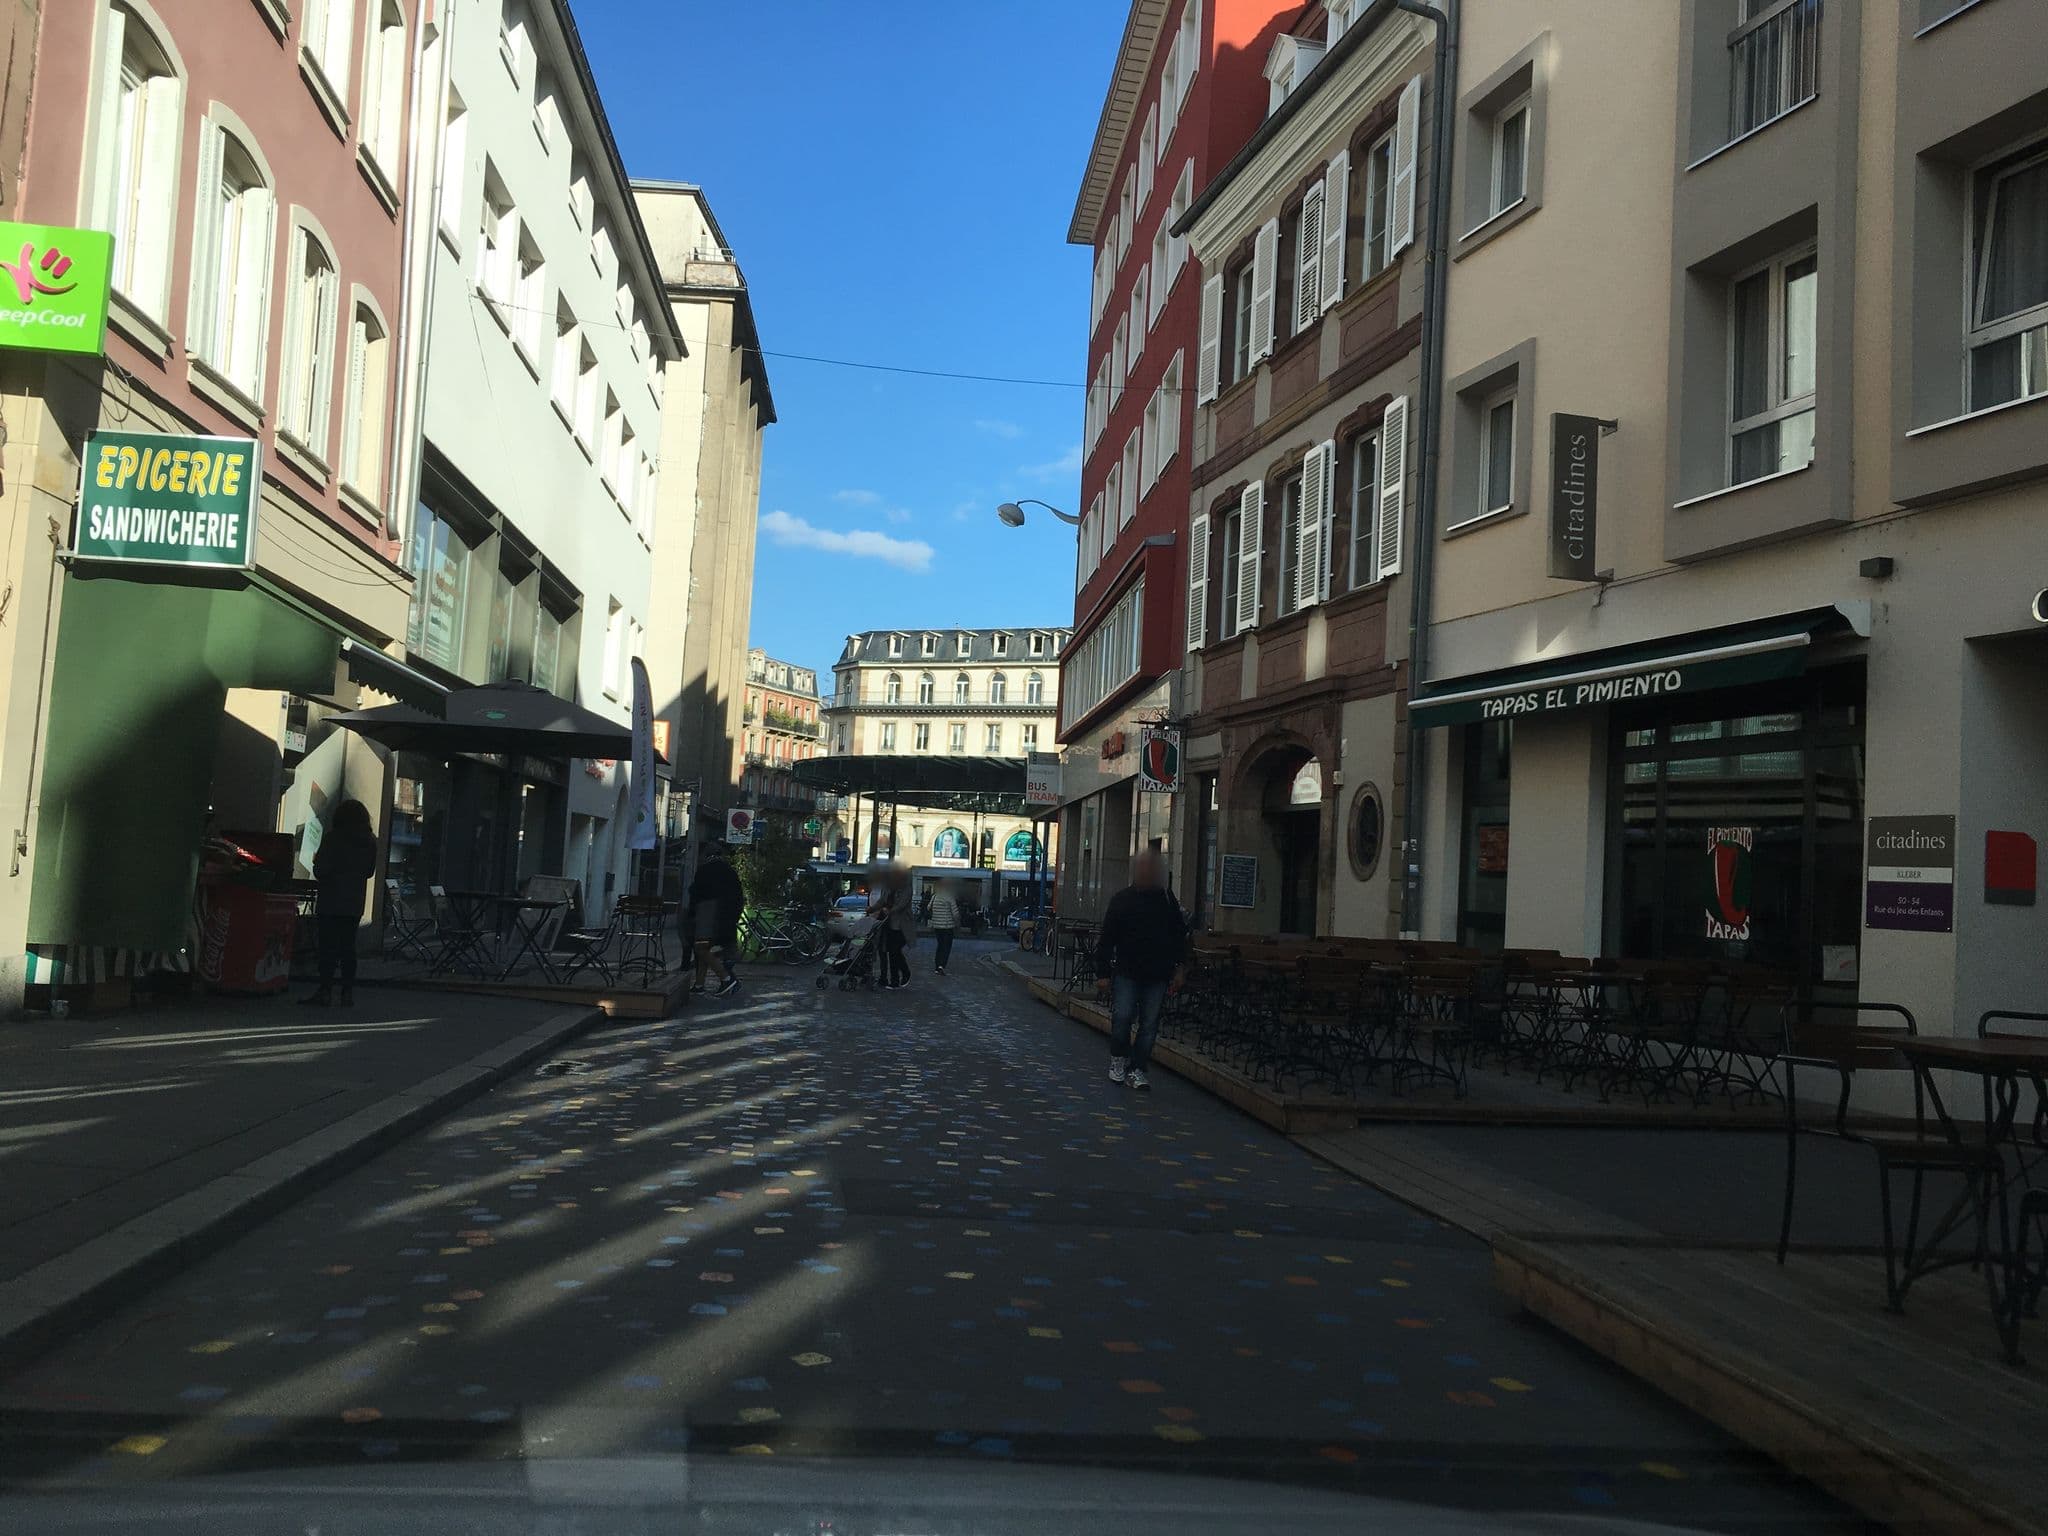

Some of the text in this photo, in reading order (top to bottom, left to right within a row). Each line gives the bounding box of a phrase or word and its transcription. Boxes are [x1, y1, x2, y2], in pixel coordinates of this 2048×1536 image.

[96, 445, 244, 498] EPICERIE
[1561, 433, 1587, 560] citadines
[89, 504, 240, 549] SANDWICHERIE
[1481, 669, 1682, 719] TAPAS EL PIMIENTO
[1028, 782, 1047, 792] BUS
[1028, 792, 1057, 801] TRAM
[1706, 827, 1717, 855] EL
[1876, 829, 1946, 849] citadines
[1920, 908, 1944, 917] Enfants
